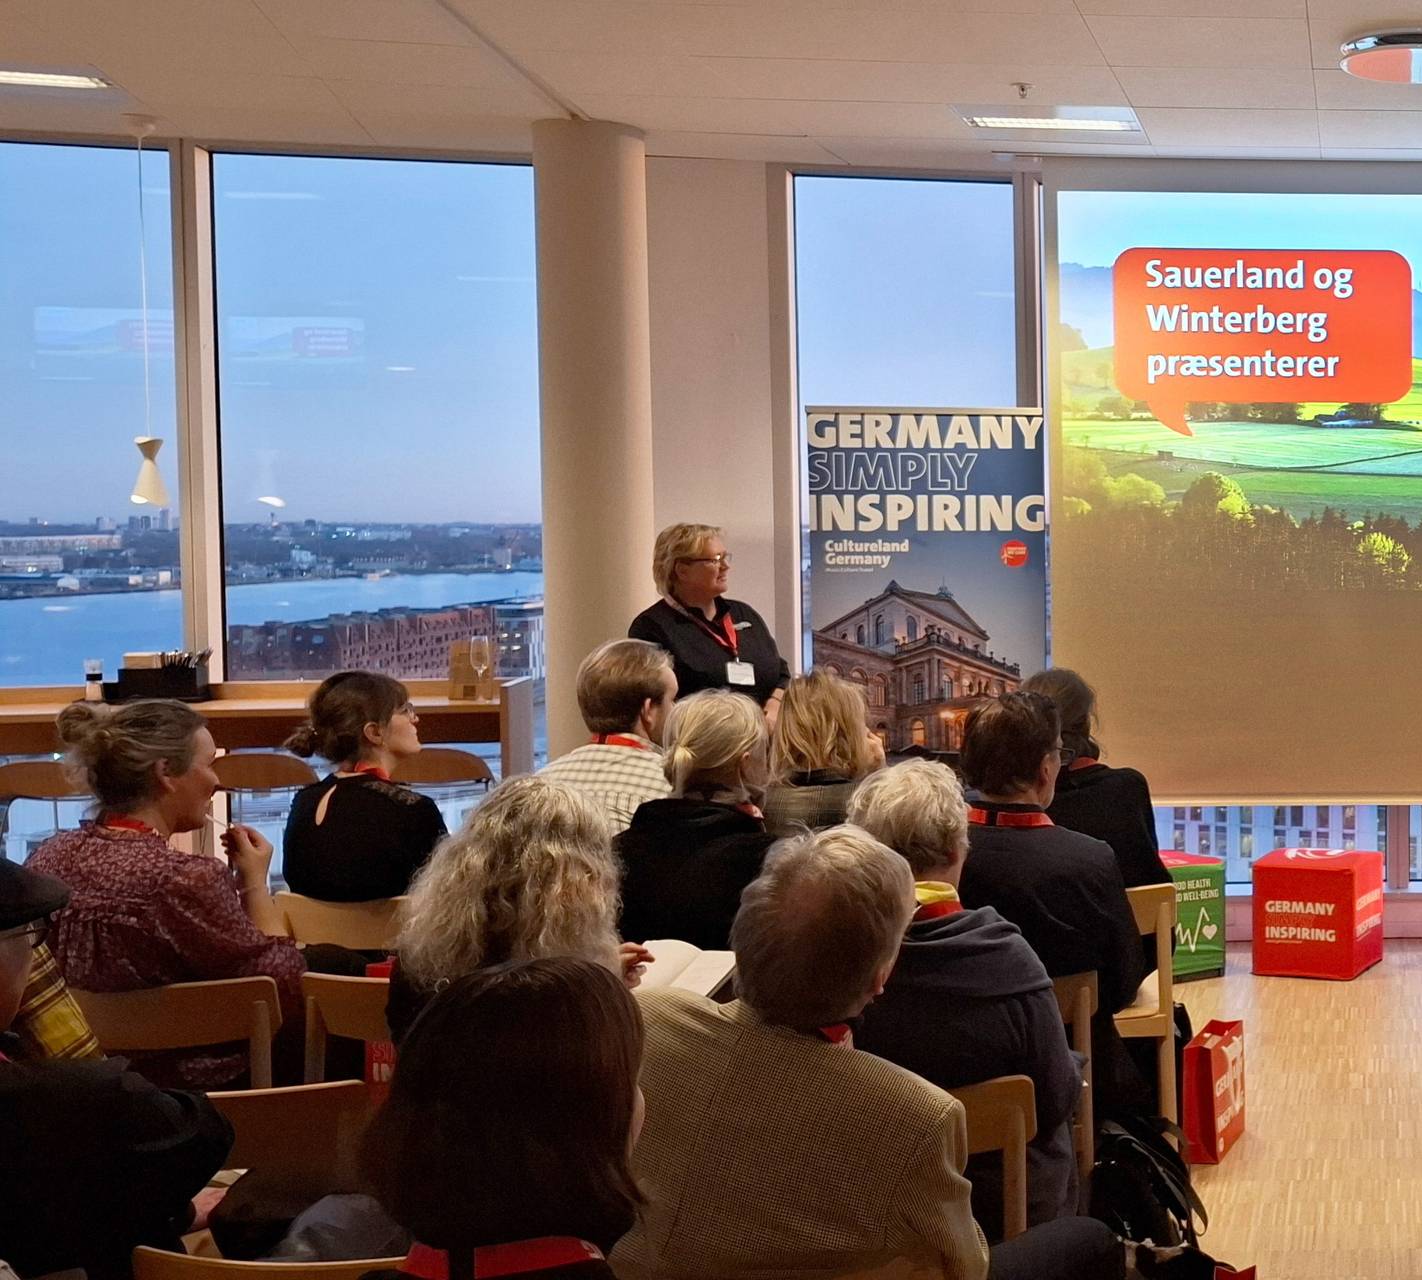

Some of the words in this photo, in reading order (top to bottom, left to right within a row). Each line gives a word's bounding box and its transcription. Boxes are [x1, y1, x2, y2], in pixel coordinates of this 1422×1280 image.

[1145, 259, 1304, 289] Sauerland
[1313, 267, 1353, 299] og
[1145, 304, 1327, 342] Winterberg
[1147, 350, 1340, 384] præsenterer
[807, 413, 1044, 449] GERMANY
[808, 452, 978, 490] SIMPLY
[809, 493, 1045, 532] INSPIRING
[825, 538, 910, 552] Cultureland
[825, 552, 892, 569] Germany
[1187, 878, 1211, 890] HEALTH
[1264, 900, 1336, 916] GERMANY
[1264, 926, 1337, 942] INSPIRING
